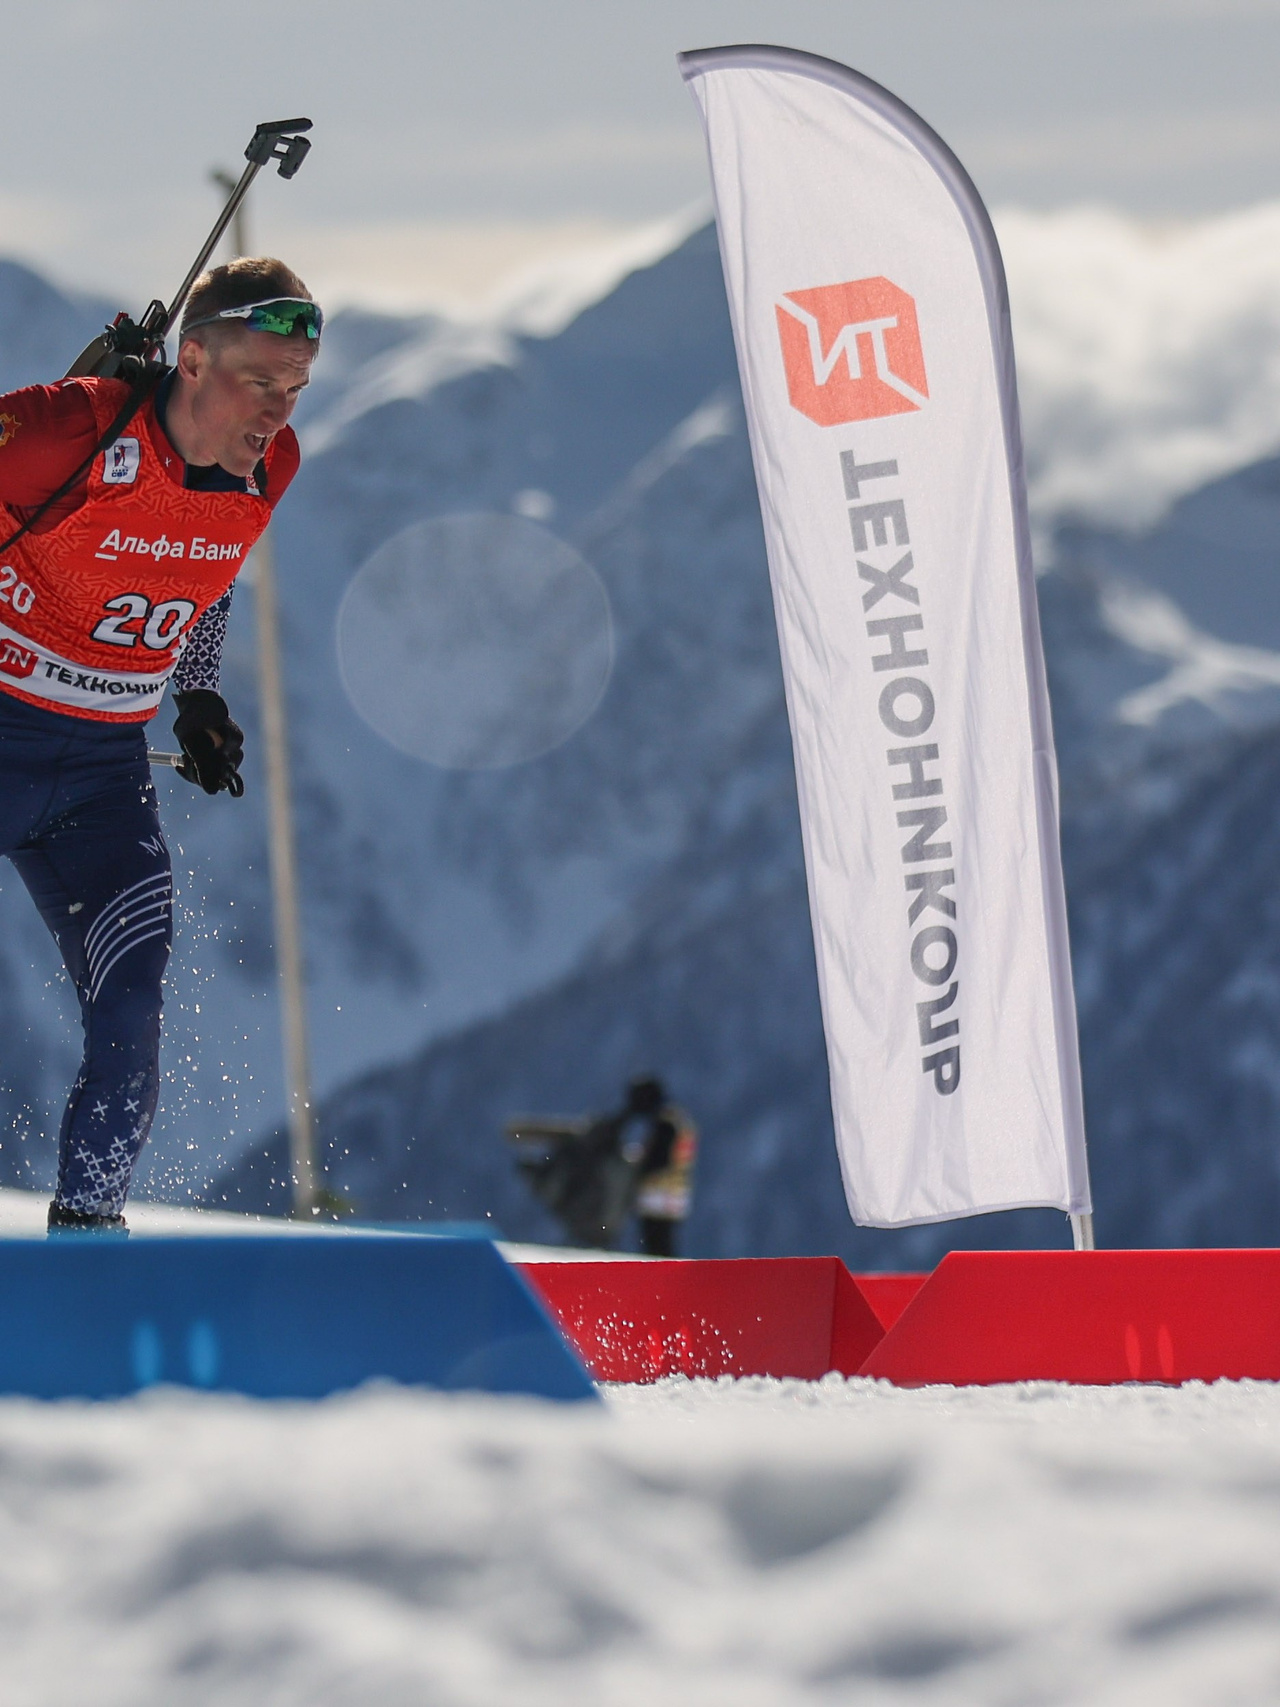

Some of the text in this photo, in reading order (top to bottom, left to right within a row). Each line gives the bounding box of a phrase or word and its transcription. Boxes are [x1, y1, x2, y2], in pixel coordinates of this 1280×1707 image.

[94, 528, 243, 562] Альфа Банк
[90, 592, 198, 651] 20
